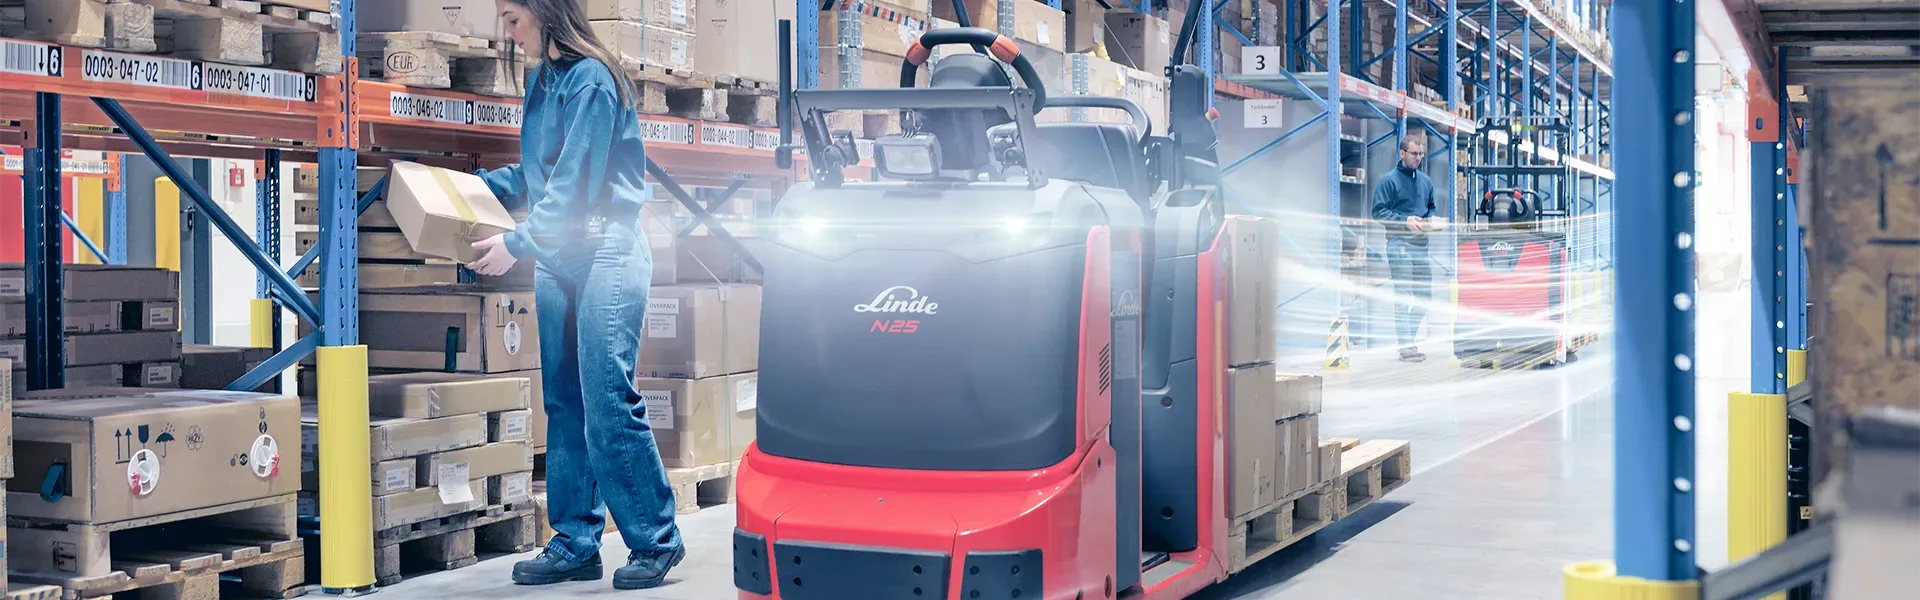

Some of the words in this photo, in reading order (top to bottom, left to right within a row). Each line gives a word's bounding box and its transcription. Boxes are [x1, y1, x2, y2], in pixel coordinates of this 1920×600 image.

[48, 48, 60, 75] 6
[393, 55, 414, 70] EUR
[1255, 54, 1266, 71] 3
[85, 54, 158, 83] 0003-047-02
[191, 64, 201, 88] 6
[207, 66, 271, 93] 0003-047-01
[305, 76, 315, 99] 9
[392, 95, 444, 119] 0003-046-02
[466, 103, 473, 123] 9
[476, 104, 522, 124] 0003-046-01
[1261, 115, 1268, 125] 3
[640, 122, 669, 140] 03-045-01
[702, 127, 736, 145] 0003-044-02
[649, 302, 677, 310] OVERPACK
[853, 285, 939, 315] Linde
[642, 394, 669, 402] OVERPACK
